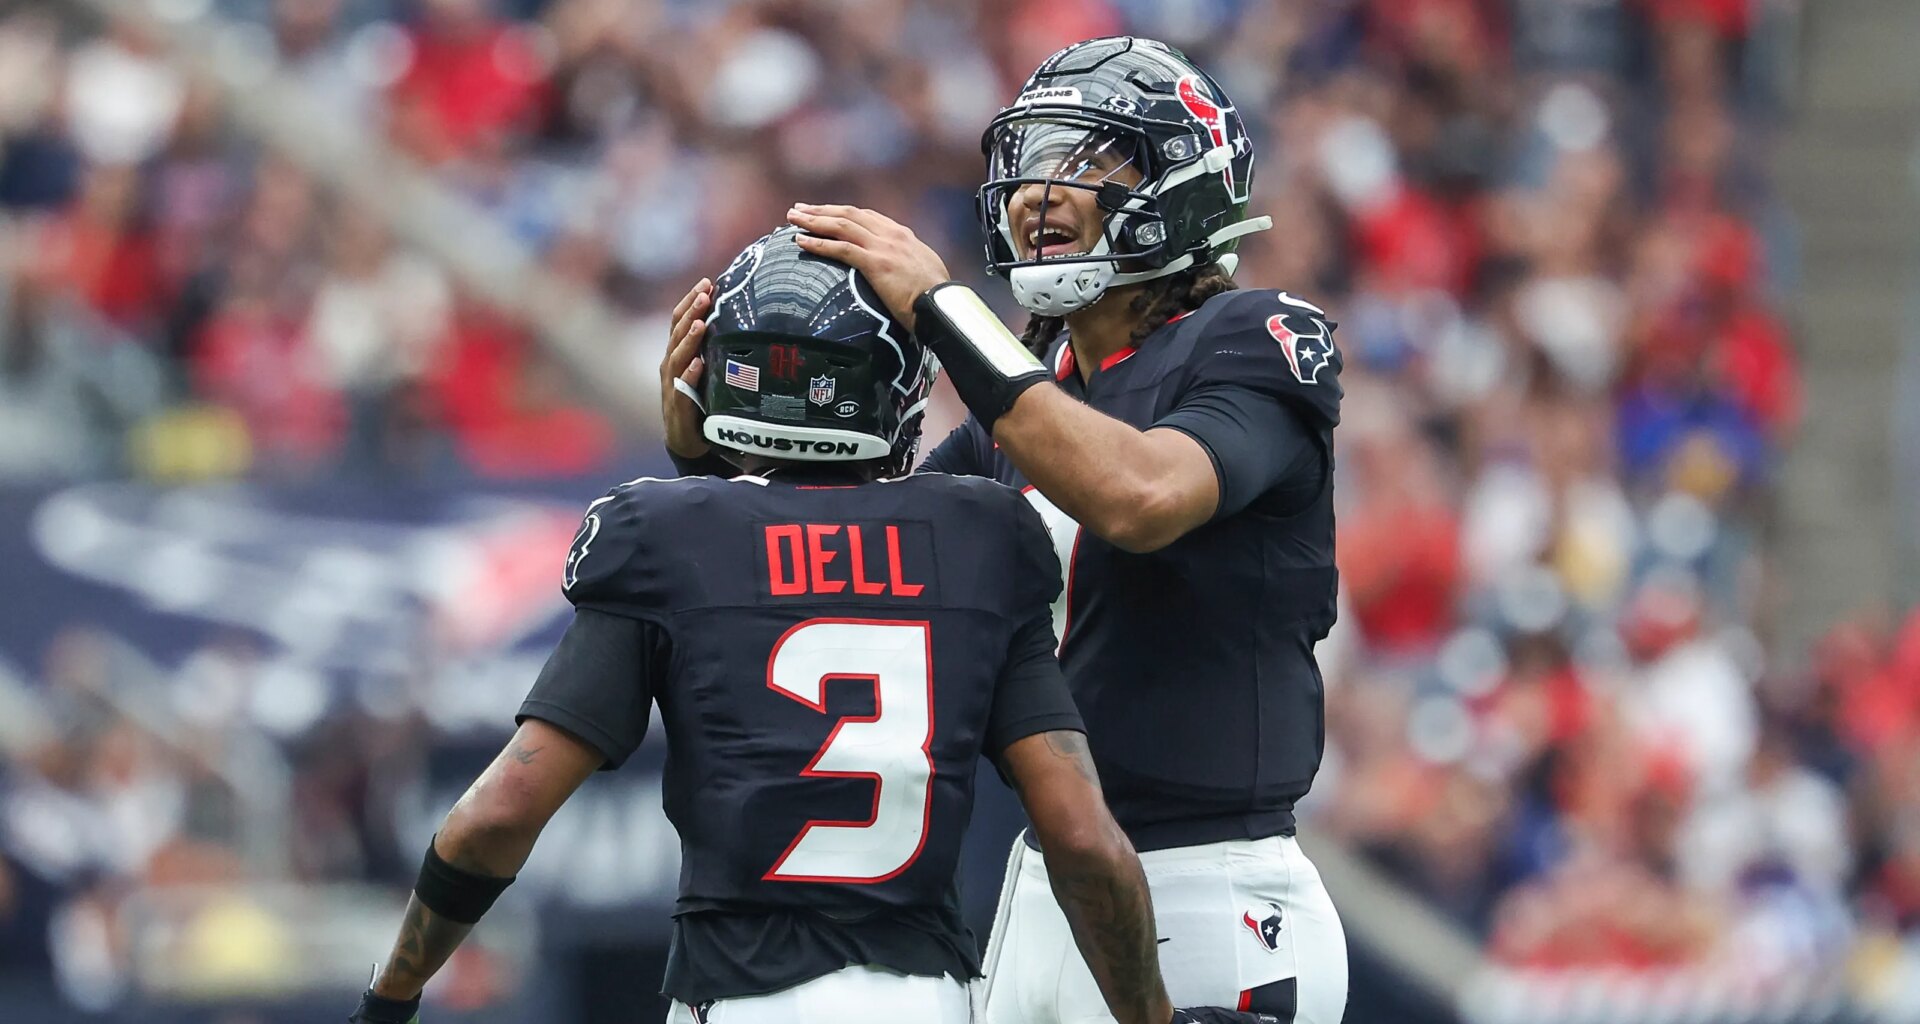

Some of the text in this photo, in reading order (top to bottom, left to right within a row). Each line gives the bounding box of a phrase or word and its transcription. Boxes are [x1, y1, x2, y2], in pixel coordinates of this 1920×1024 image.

[1022, 90, 1073, 101] TEXANS
[813, 388, 831, 401] NFL
[717, 428, 859, 455] HOUSTON
[765, 524, 925, 597] DELL
[761, 616, 936, 884] 3
